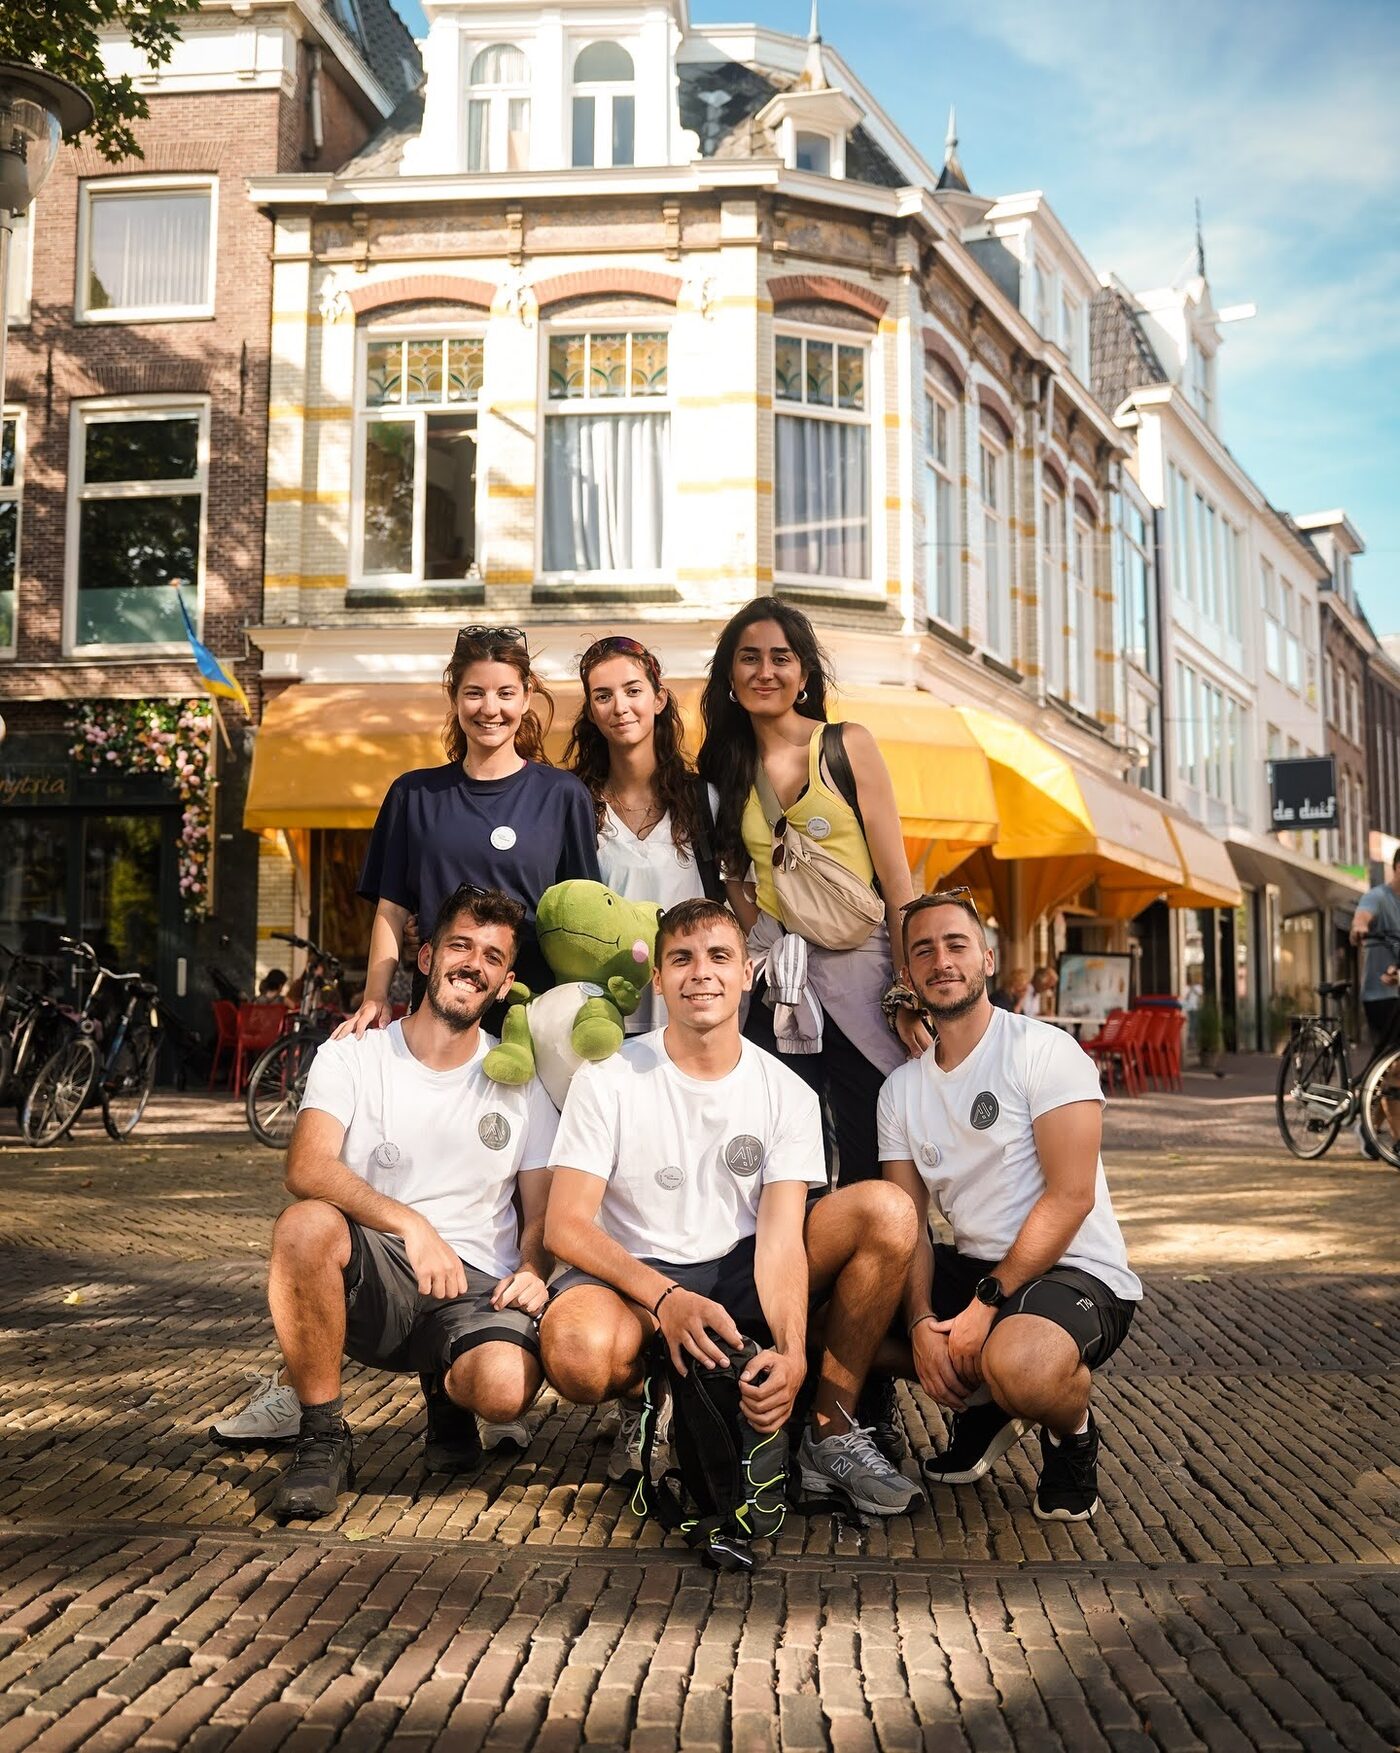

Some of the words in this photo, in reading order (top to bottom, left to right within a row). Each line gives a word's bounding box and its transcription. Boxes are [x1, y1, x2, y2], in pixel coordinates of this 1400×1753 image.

[1273, 799, 1294, 821] de
[1299, 796, 1335, 819] duif
[264, 1397, 296, 1423] N
[830, 1455, 854, 1478] N
